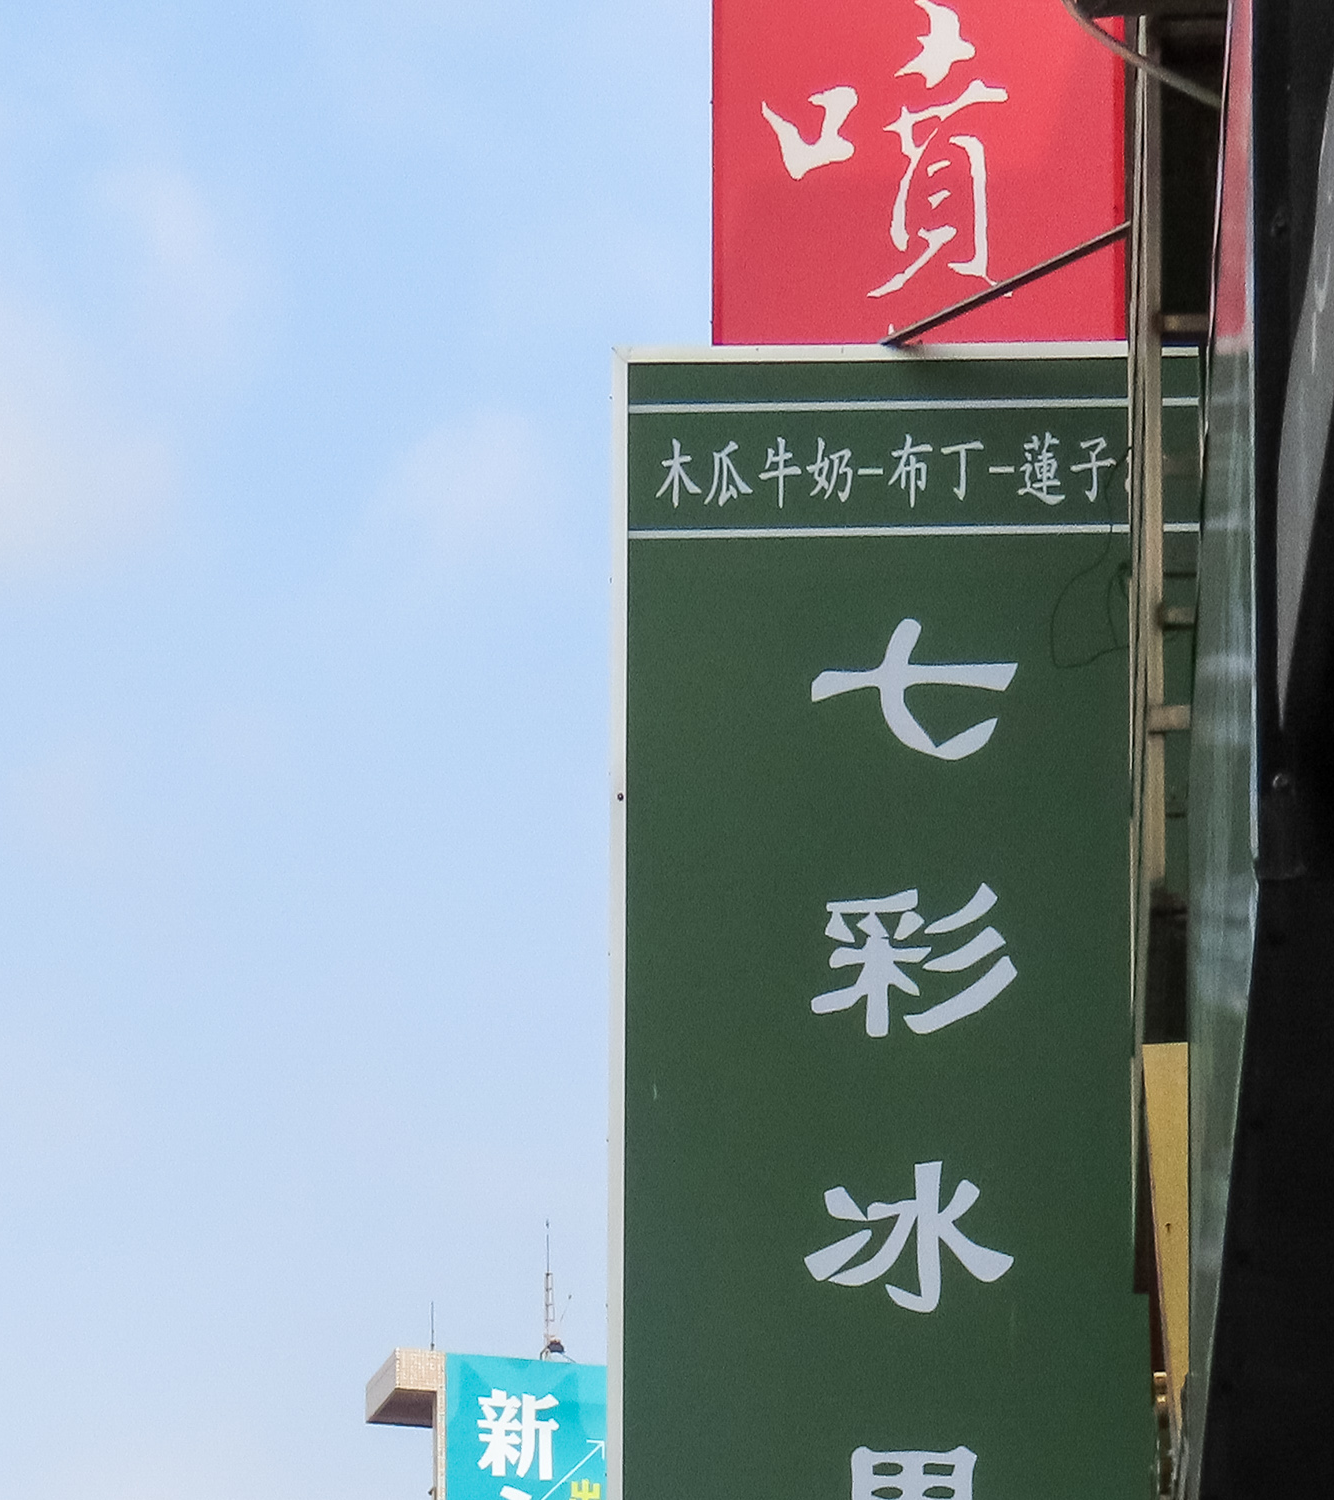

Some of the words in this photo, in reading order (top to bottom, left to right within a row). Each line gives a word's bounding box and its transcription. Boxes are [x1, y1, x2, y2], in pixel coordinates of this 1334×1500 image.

[656, 431, 1132, 508] 木瓜牛奶-布丁-蓮子
